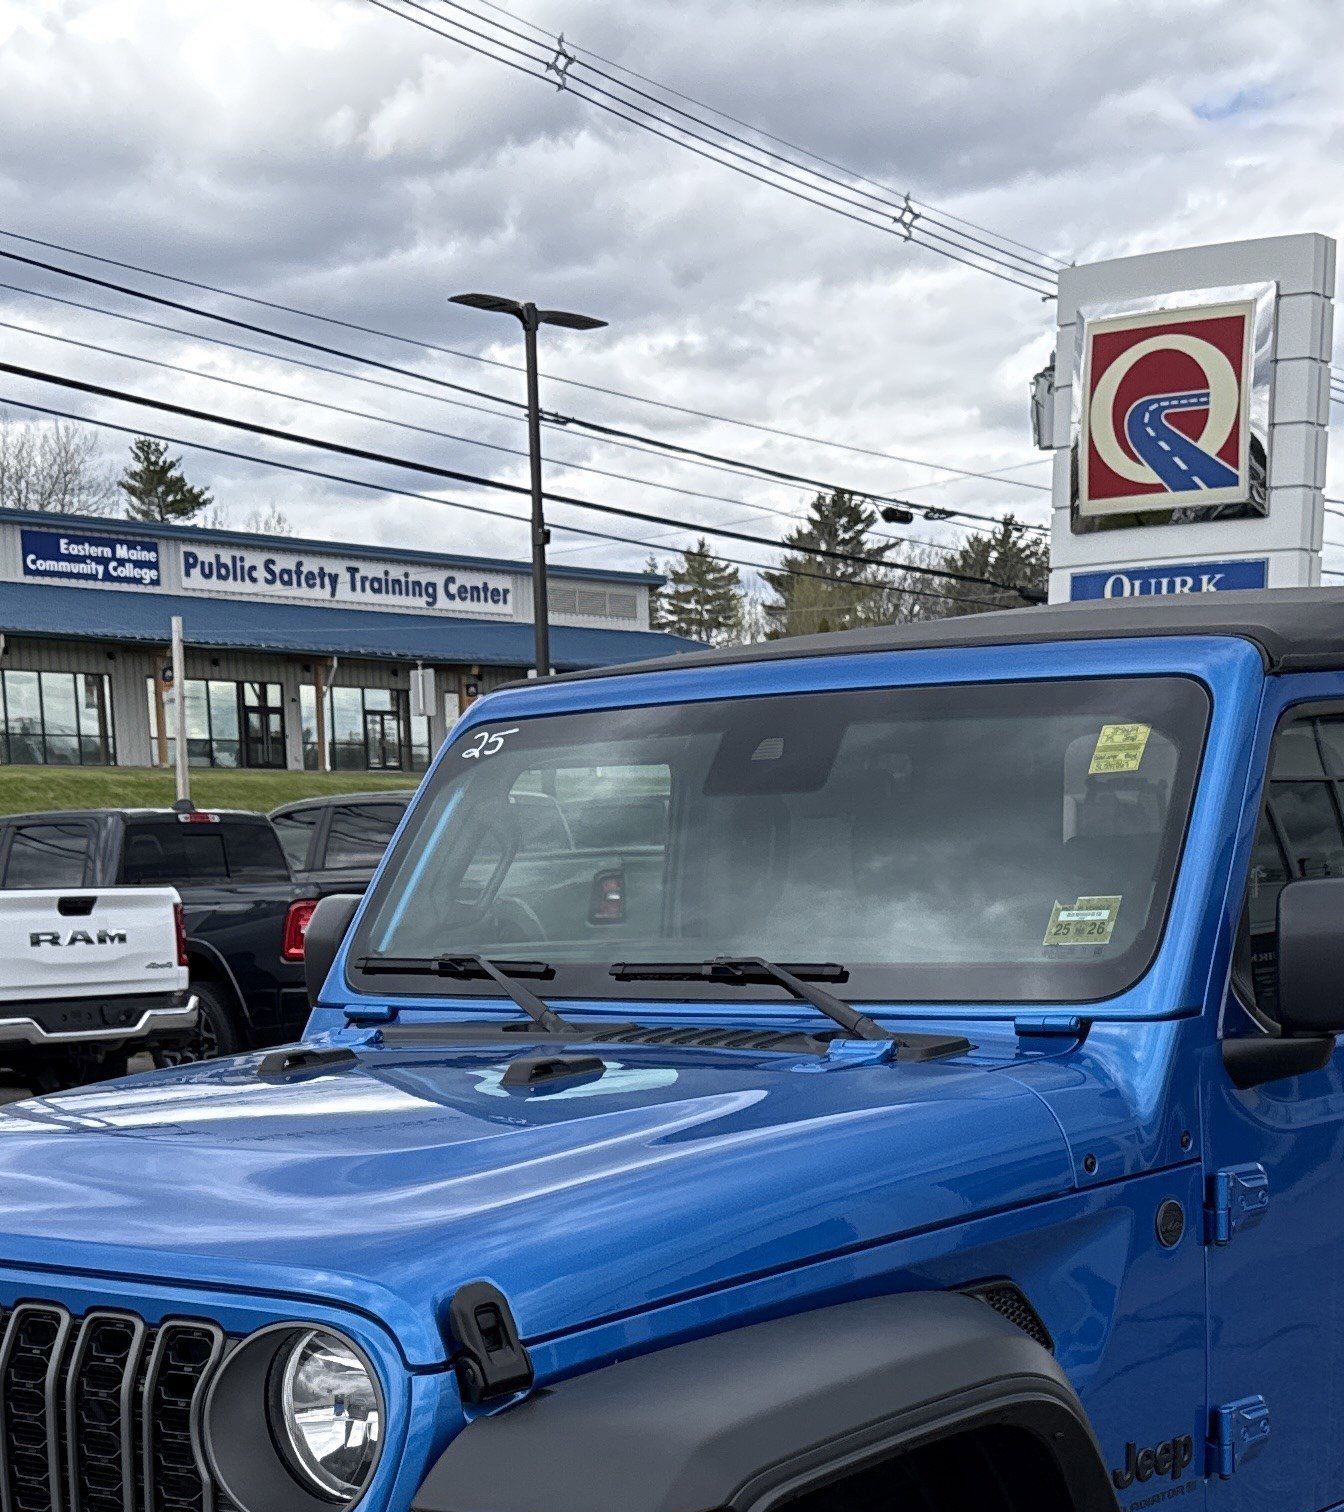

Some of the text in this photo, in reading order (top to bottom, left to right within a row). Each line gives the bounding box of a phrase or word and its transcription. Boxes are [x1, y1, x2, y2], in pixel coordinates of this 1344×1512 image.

[59, 538, 158, 562] Eastern Maine
[26, 554, 158, 584] Community College
[182, 551, 511, 607] Public Safety Training Center
[462, 728, 520, 758] 25
[29, 929, 127, 947] RAM
[1054, 922, 1106, 936] 25 26
[1112, 1434, 1193, 1489] Jeep
